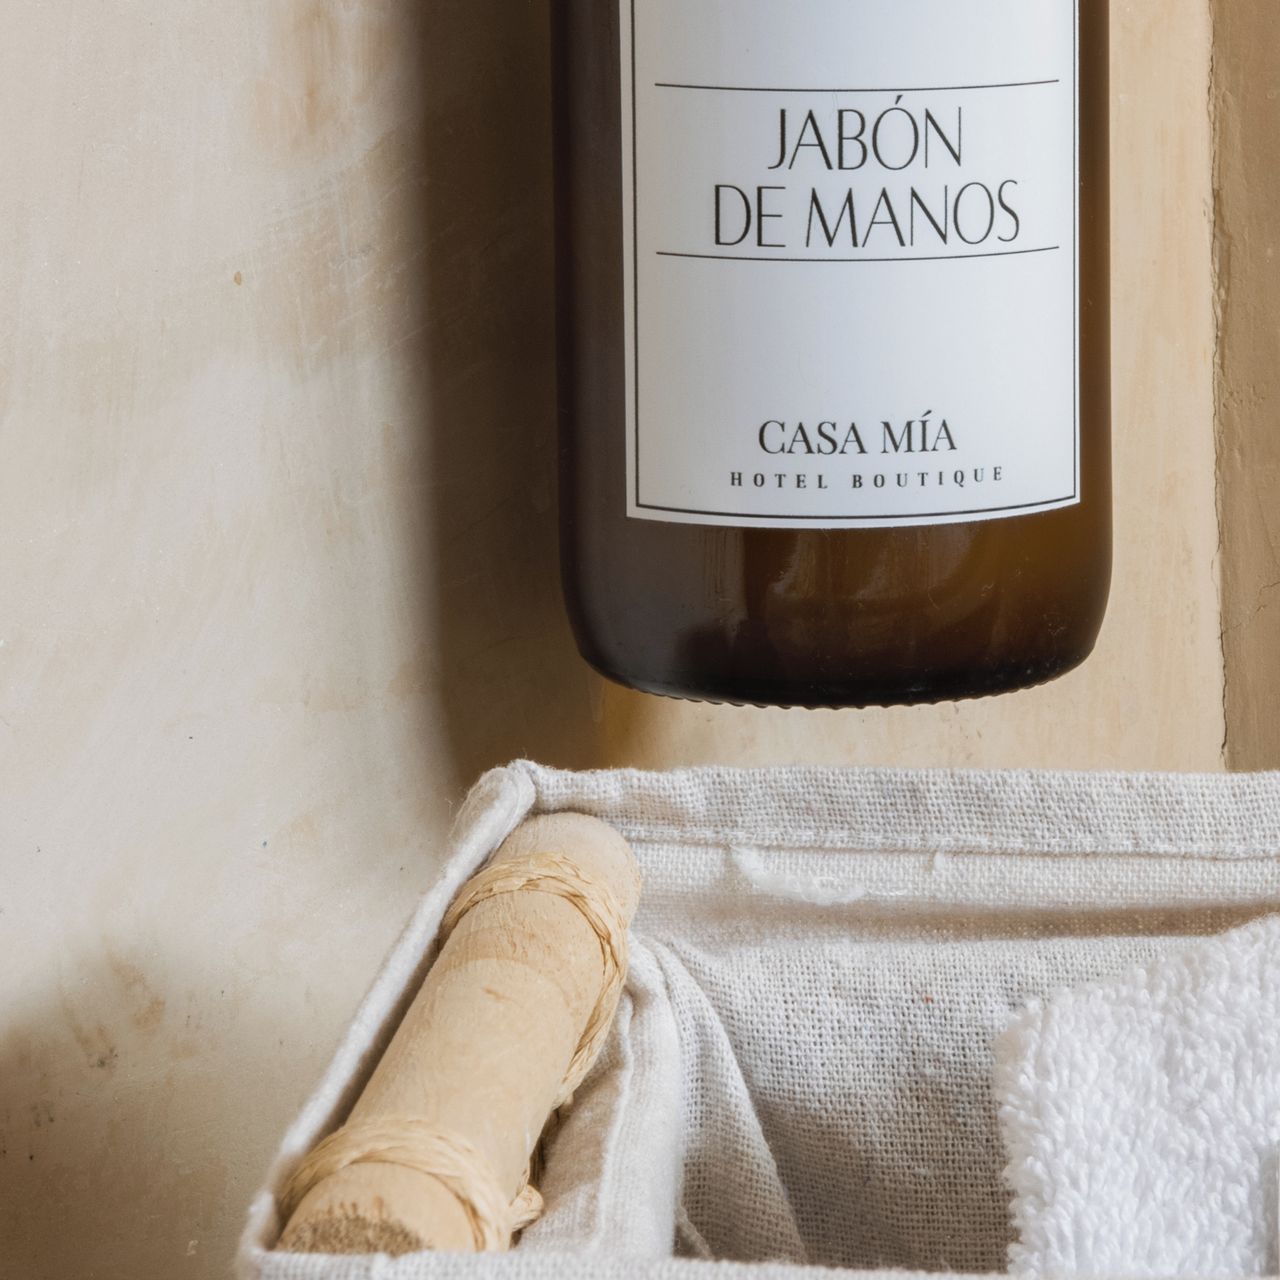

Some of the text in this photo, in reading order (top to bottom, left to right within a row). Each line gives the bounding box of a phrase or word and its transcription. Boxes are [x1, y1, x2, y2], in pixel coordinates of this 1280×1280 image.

[768, 95, 961, 170] JABÓN
[714, 180, 1019, 247] DE MANOS
[758, 410, 957, 455] CASA MÍA
[730, 465, 1003, 489] HOTEL BOUTIQUE
